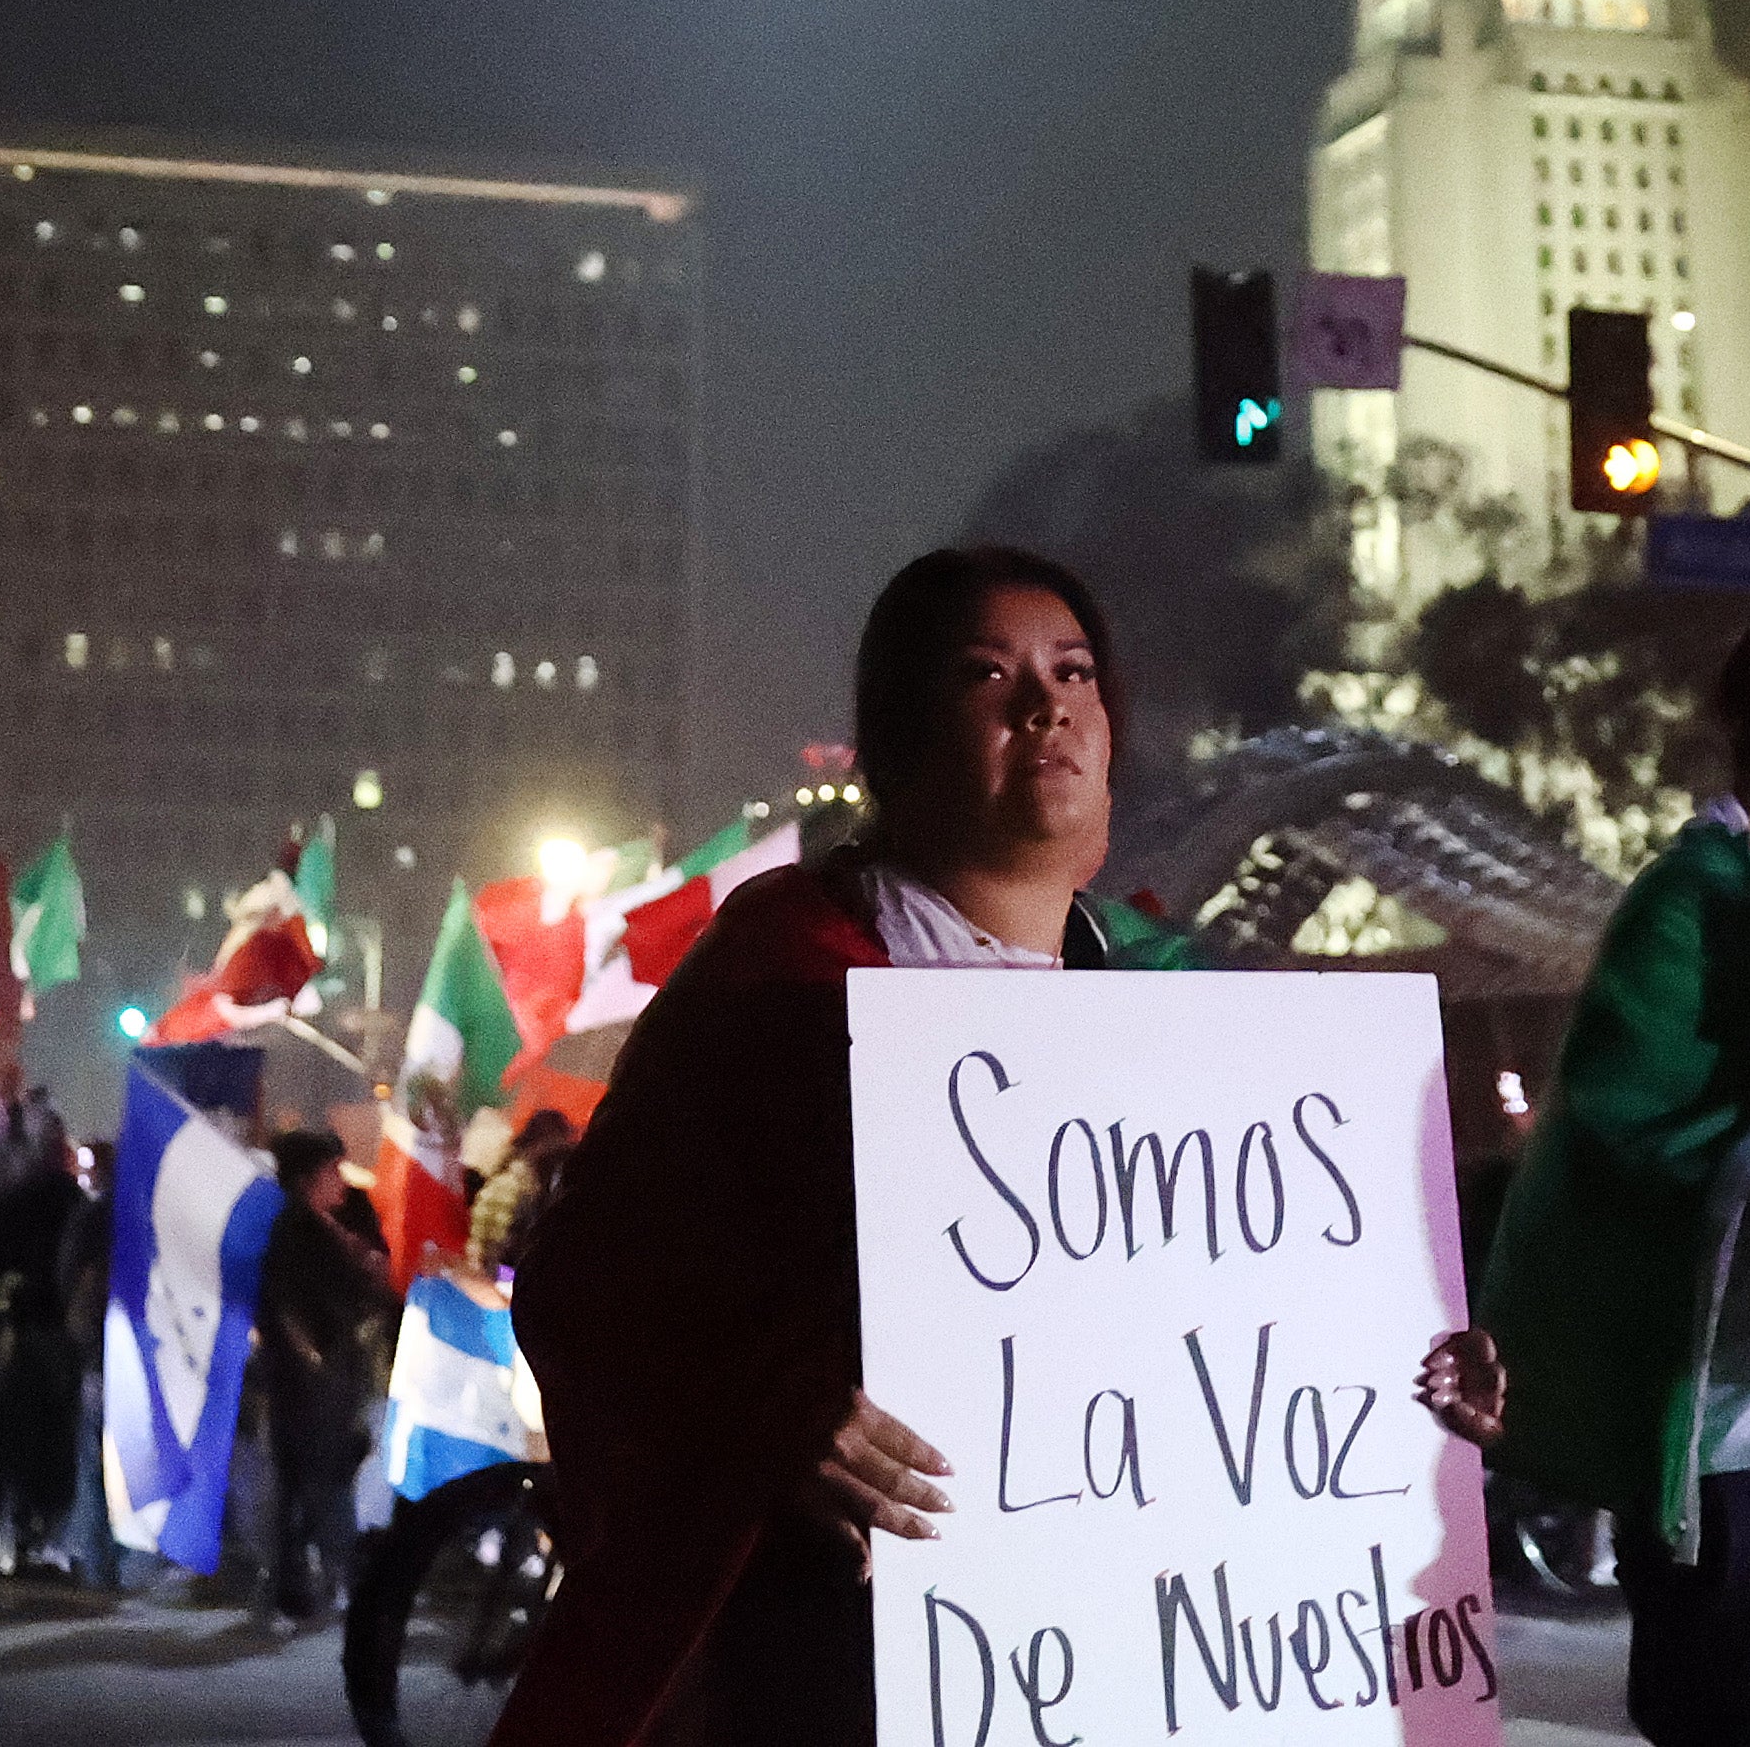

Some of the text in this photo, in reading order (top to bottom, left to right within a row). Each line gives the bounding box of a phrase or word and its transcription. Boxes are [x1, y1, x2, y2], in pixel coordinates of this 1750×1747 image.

[943, 1051, 1362, 1292] Somos
[999, 1322, 1410, 1512] La Voz
[924, 1545, 1496, 1747] De Nuestros
